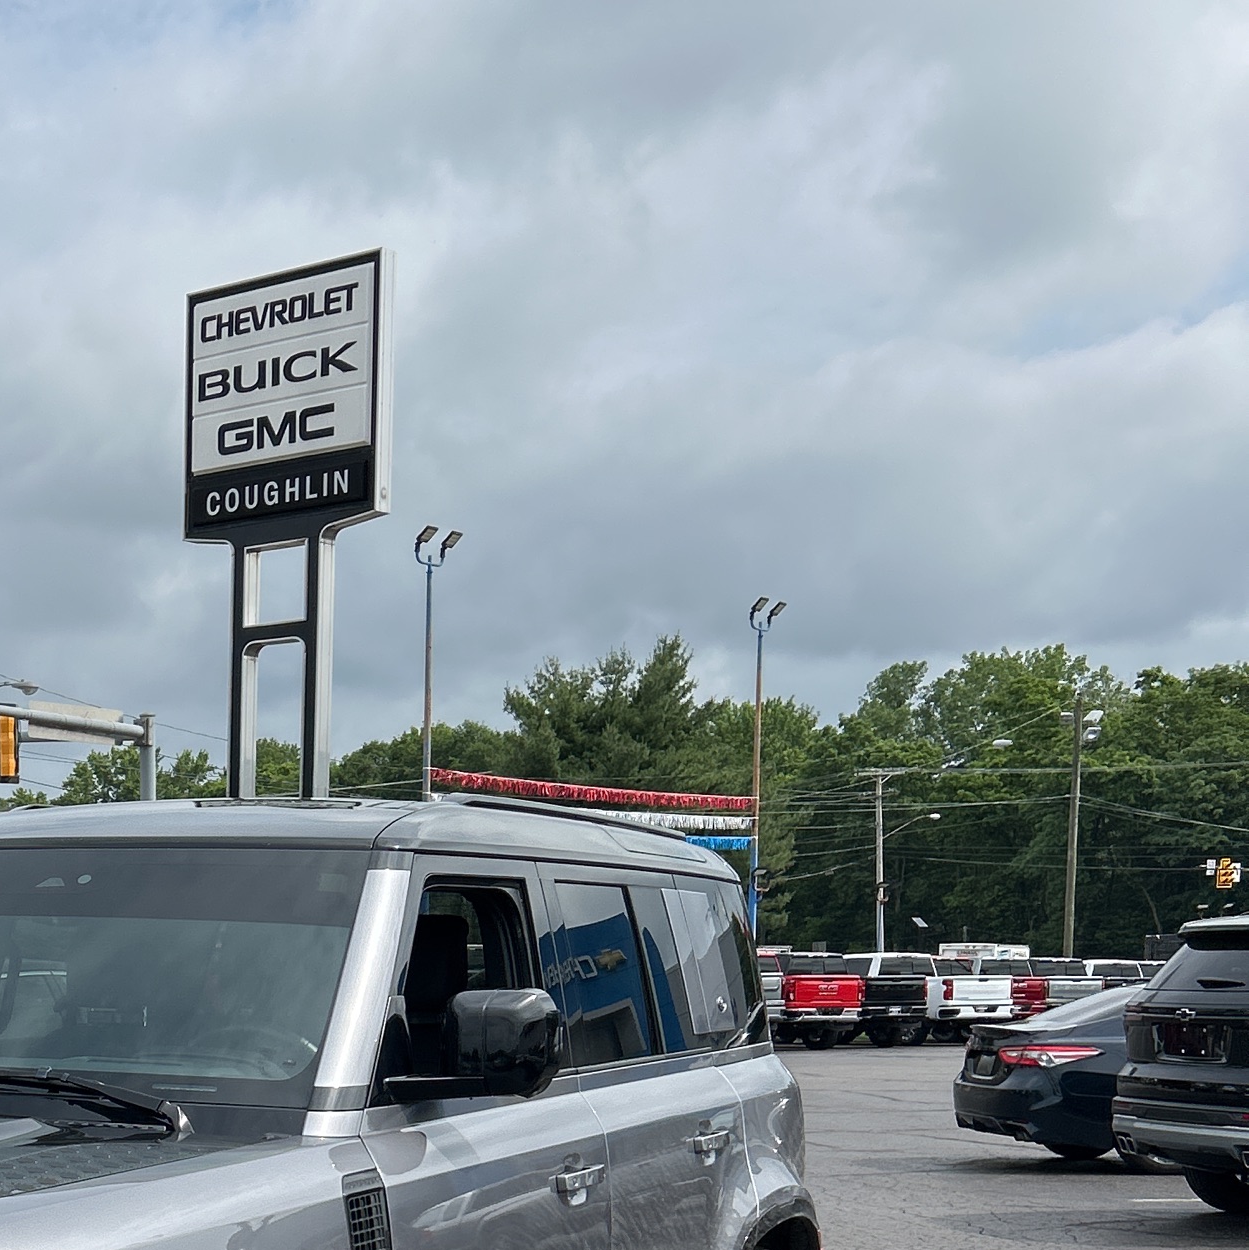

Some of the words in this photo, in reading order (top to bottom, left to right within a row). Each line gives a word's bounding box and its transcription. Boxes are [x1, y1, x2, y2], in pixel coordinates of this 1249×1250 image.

[200, 281, 359, 343] CHEVROLET
[198, 340, 358, 403] BUICK
[217, 402, 335, 456] GMC
[205, 468, 350, 516] COUGHLIN
